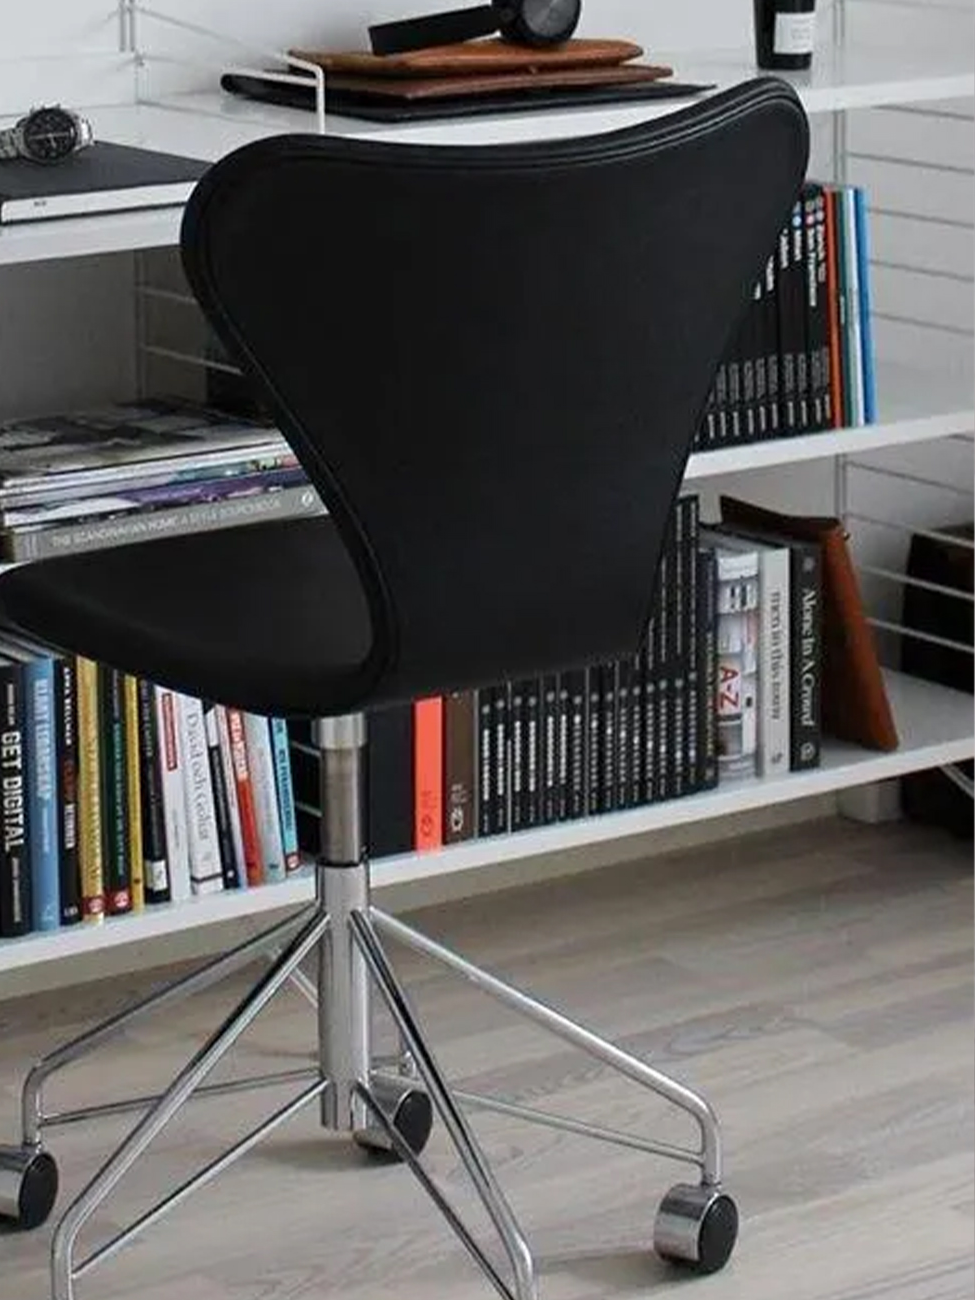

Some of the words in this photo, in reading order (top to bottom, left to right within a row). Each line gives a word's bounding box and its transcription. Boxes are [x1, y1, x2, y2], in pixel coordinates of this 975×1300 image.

[801, 587, 816, 637] Alone
[801, 657, 816, 673] A
[720, 667, 739, 710] A-Z
[801, 673, 817, 726] Crowd
[1, 731, 22, 772] GET
[2, 776, 25, 853] DIGITAL
